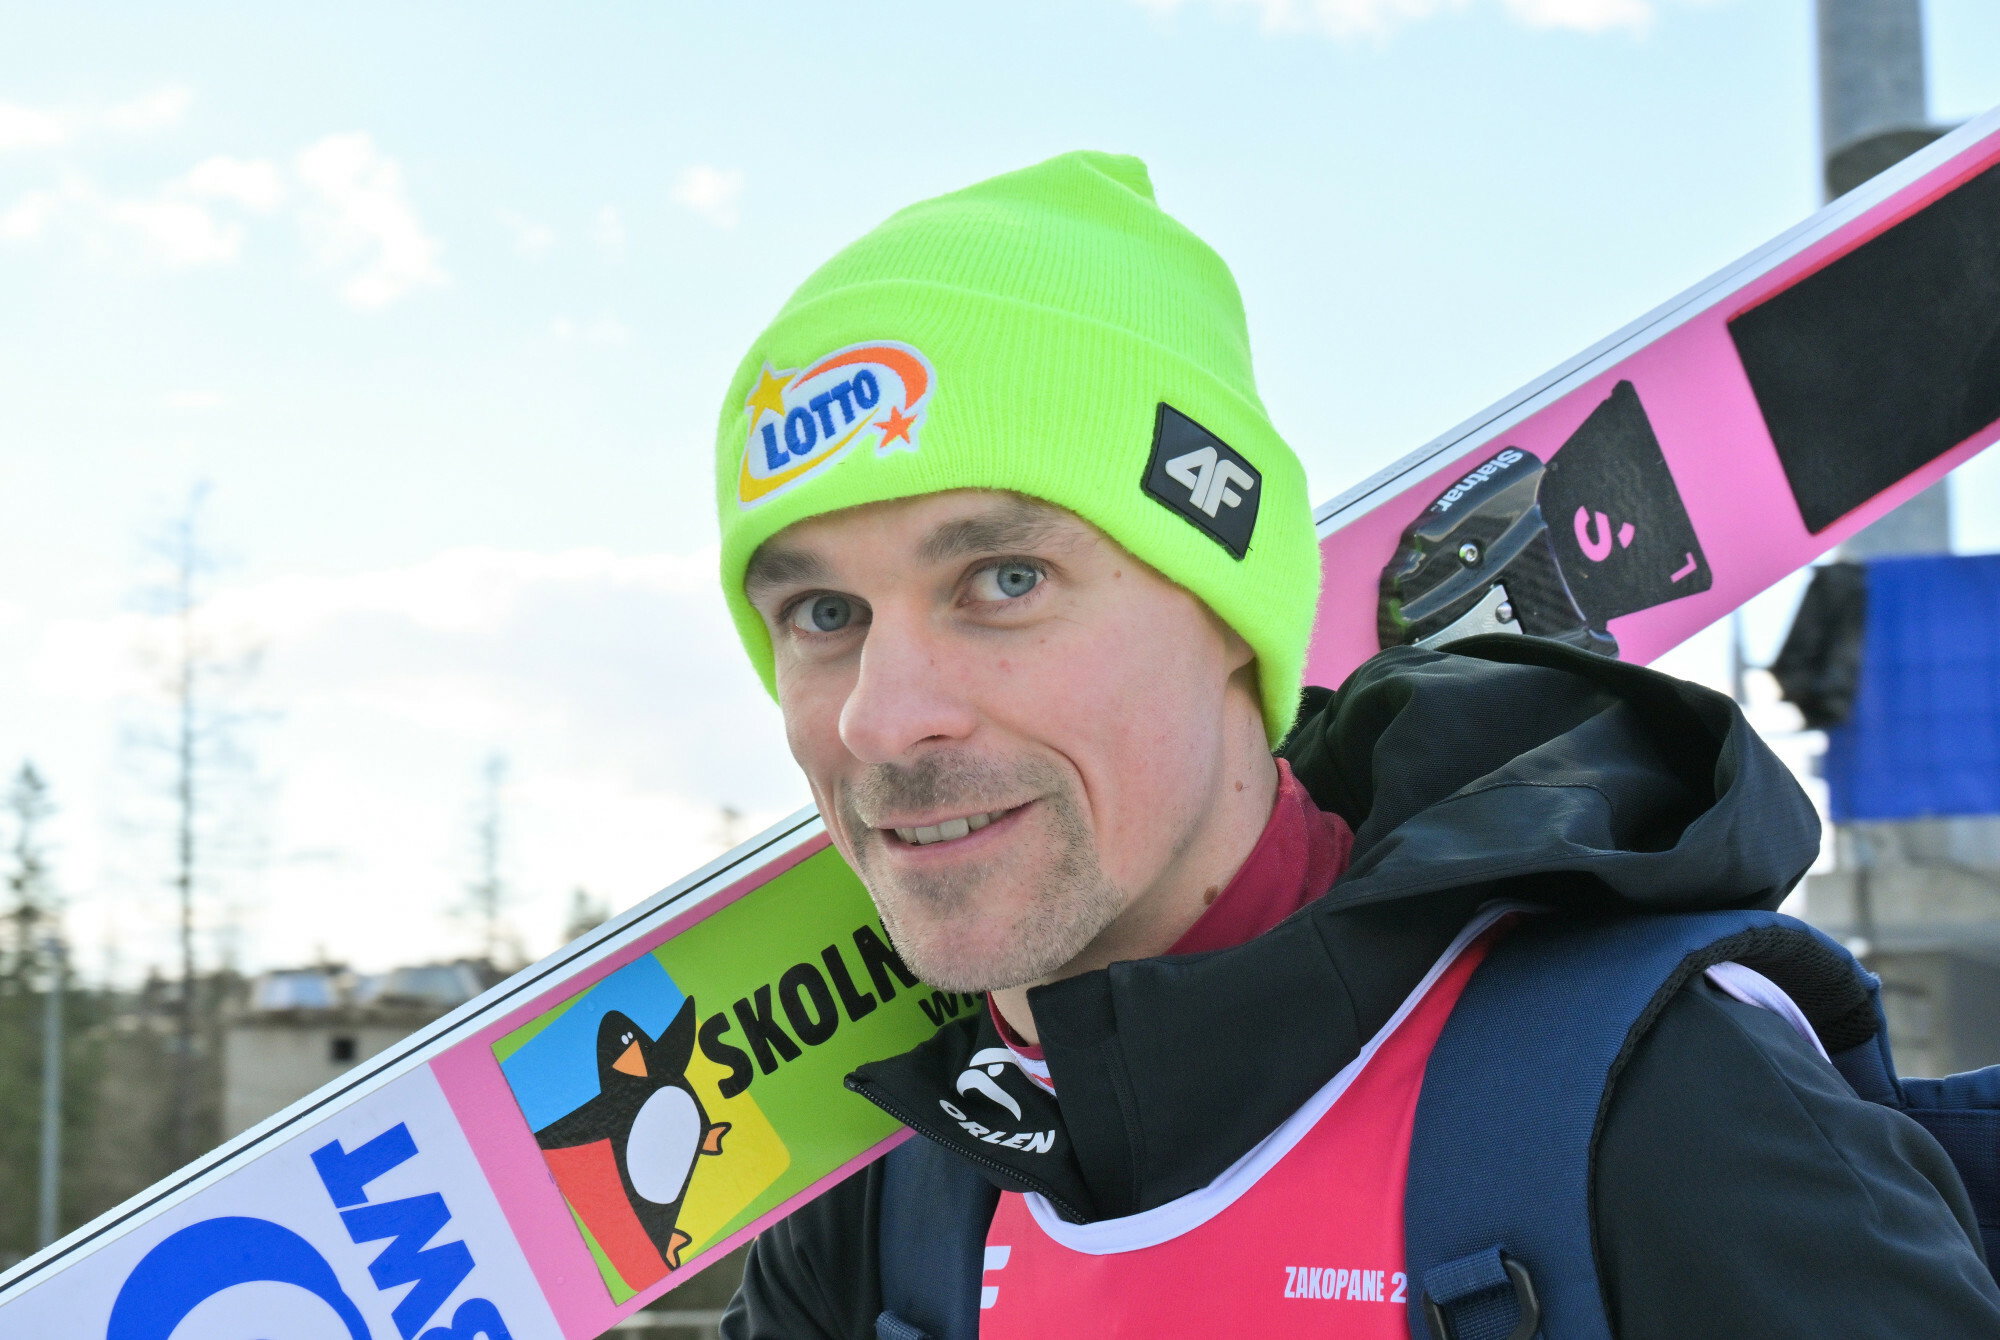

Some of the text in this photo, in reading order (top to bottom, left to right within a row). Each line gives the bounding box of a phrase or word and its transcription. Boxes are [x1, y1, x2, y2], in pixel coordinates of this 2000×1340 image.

[761, 369, 880, 471] LOTTO
[1165, 446, 1254, 518] 4F
[1437, 449, 1524, 512] Slatnar
[939, 1099, 1055, 1154] ORLEN
[1284, 1266, 1385, 1302] ZAKOPANE
